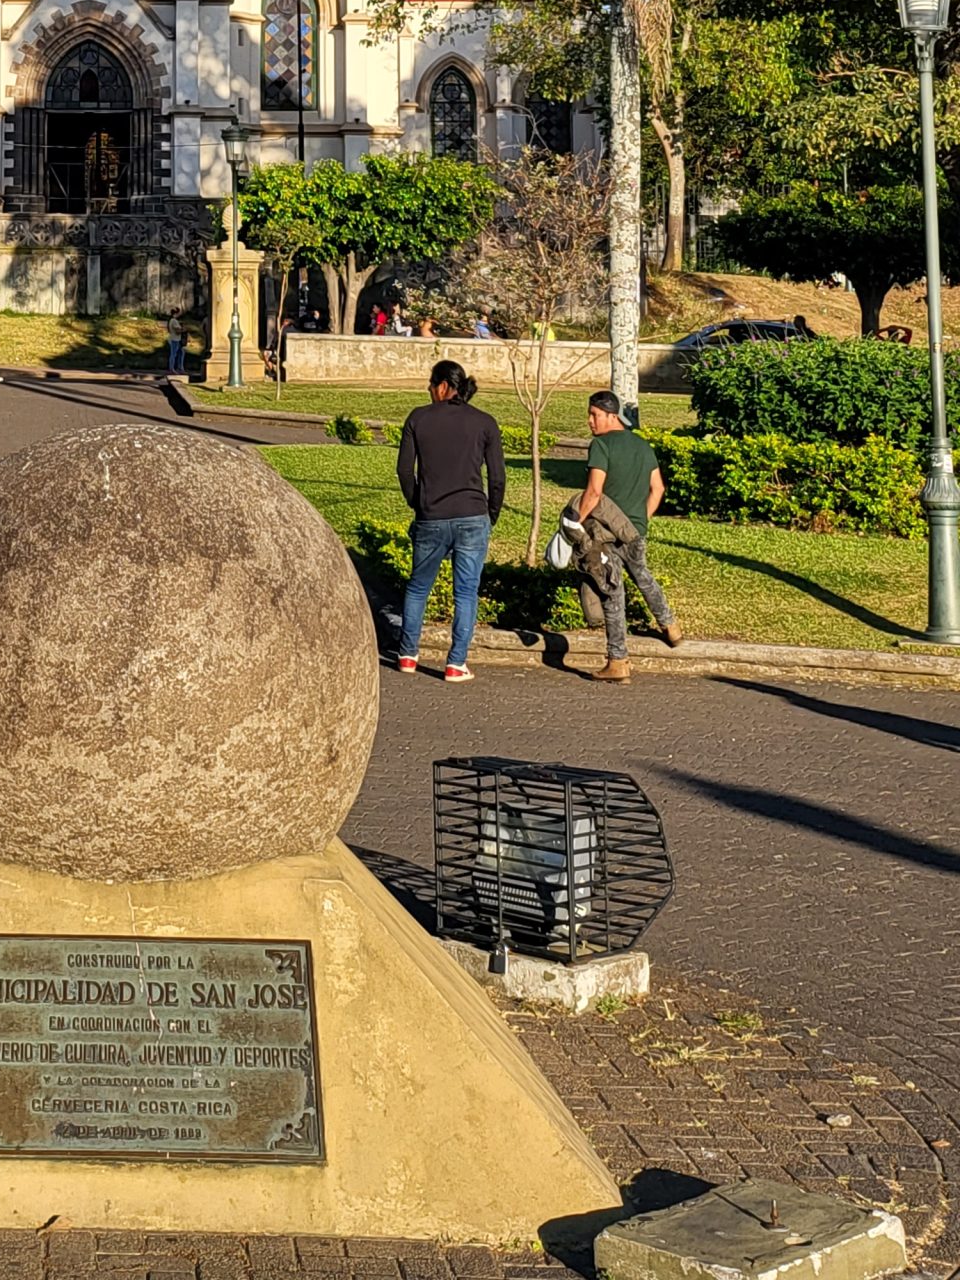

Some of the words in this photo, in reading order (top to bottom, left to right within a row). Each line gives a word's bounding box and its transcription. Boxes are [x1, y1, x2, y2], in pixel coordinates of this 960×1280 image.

[67, 953, 141, 970] CONSTRUIDO
[148, 955, 171, 970] POR
[178, 956, 194, 970] LA
[146, 981, 179, 1007] DE
[190, 982, 237, 1008] SAN
[49, 1015, 65, 1031] EN
[72, 1016, 161, 1032] COORDINACION
[167, 1018, 191, 1033] CON
[198, 1019, 212, 1033] EL
[39, 1042, 58, 1064] DE
[64, 1043, 131, 1067] CULTURA,
[138, 1045, 212, 1067] JUVENTUD
[217, 1046, 228, 1066] Y
[234, 1047, 309, 1070] DEPORTES
[57, 1076, 74, 1086] LA
[181, 1078, 197, 1089] DE
[205, 1078, 221, 1089] LA
[31, 1098, 130, 1114] CERVECERIA
[138, 1100, 188, 1115] COSTA
[196, 1101, 233, 1116] RICA
[77, 1125, 97, 1139] DE
[149, 1127, 168, 1140] DE
